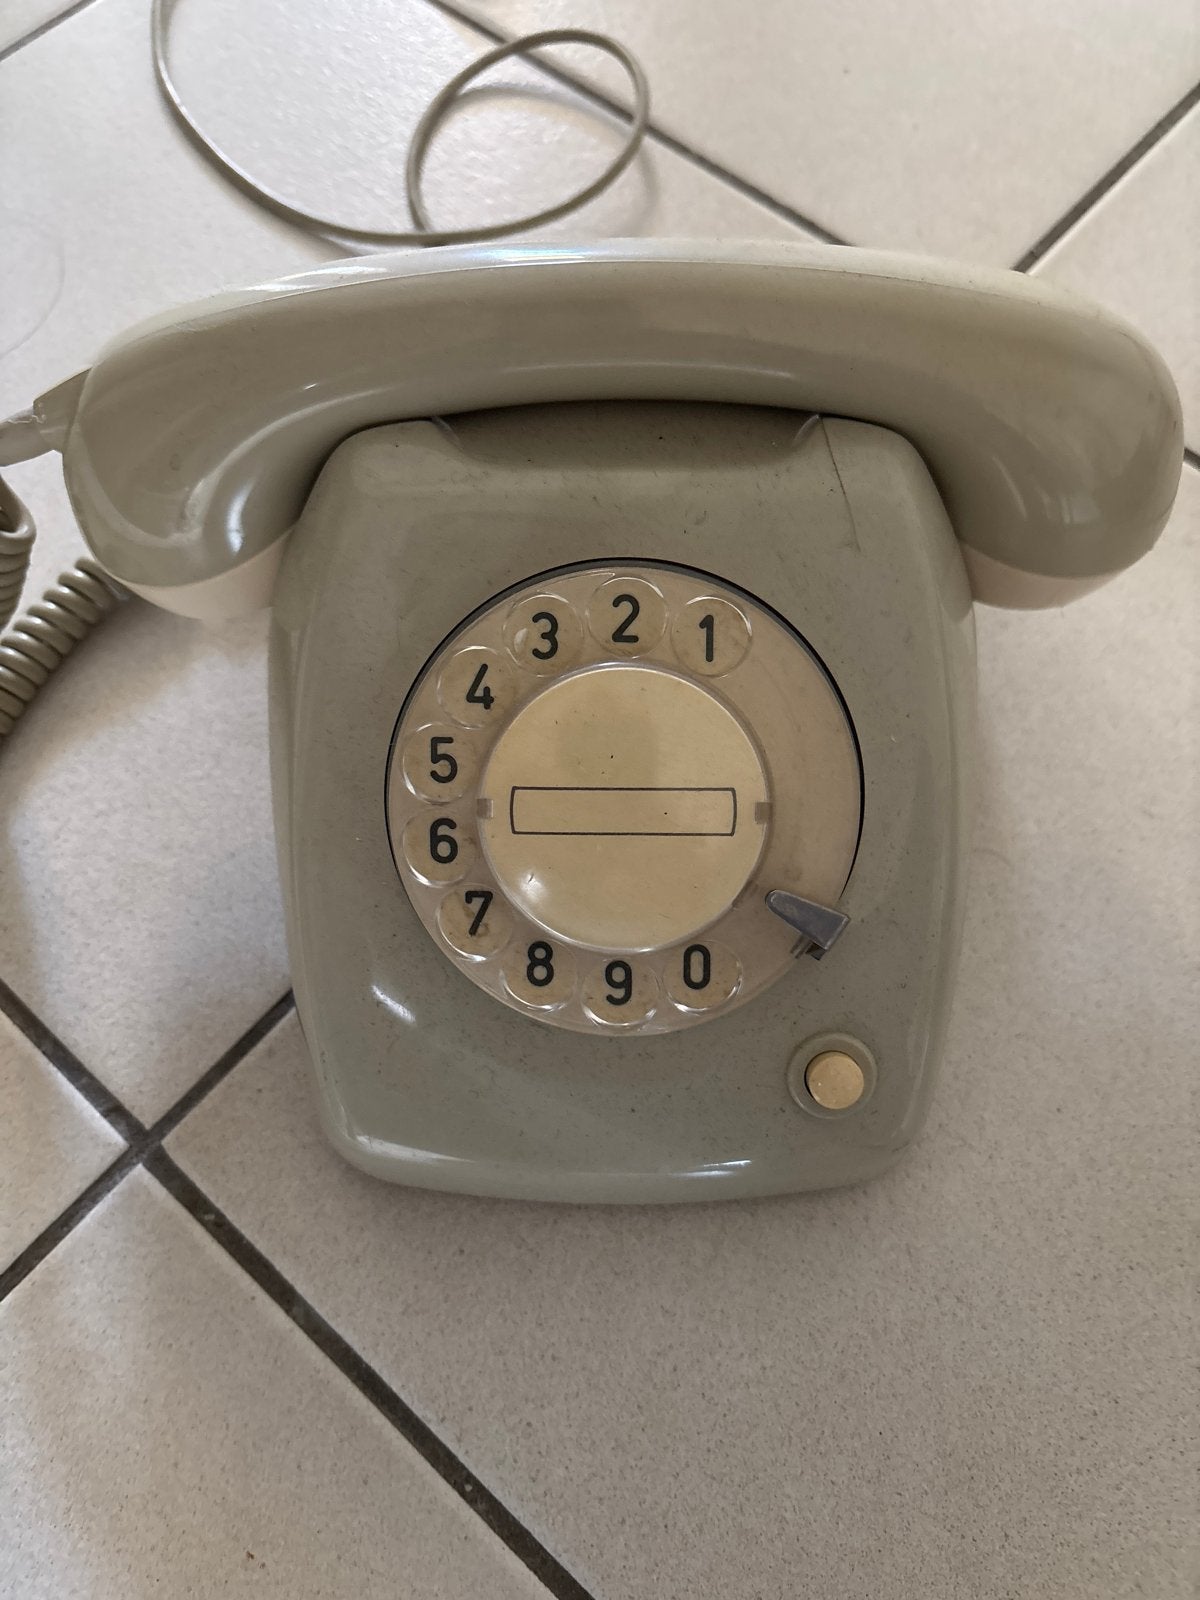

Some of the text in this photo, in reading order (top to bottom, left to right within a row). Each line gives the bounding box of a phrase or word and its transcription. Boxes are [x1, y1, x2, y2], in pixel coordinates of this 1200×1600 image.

[531, 611, 559, 661] 3
[611, 593, 641, 644] 2
[698, 614, 715, 663] 1
[465, 663, 495, 711] 4
[429, 736, 458, 784] 5
[429, 817, 459, 865] 6
[464, 889, 494, 937] 7
[526, 940, 555, 988] 8
[604, 959, 633, 1006] 9
[682, 943, 711, 991] 0
